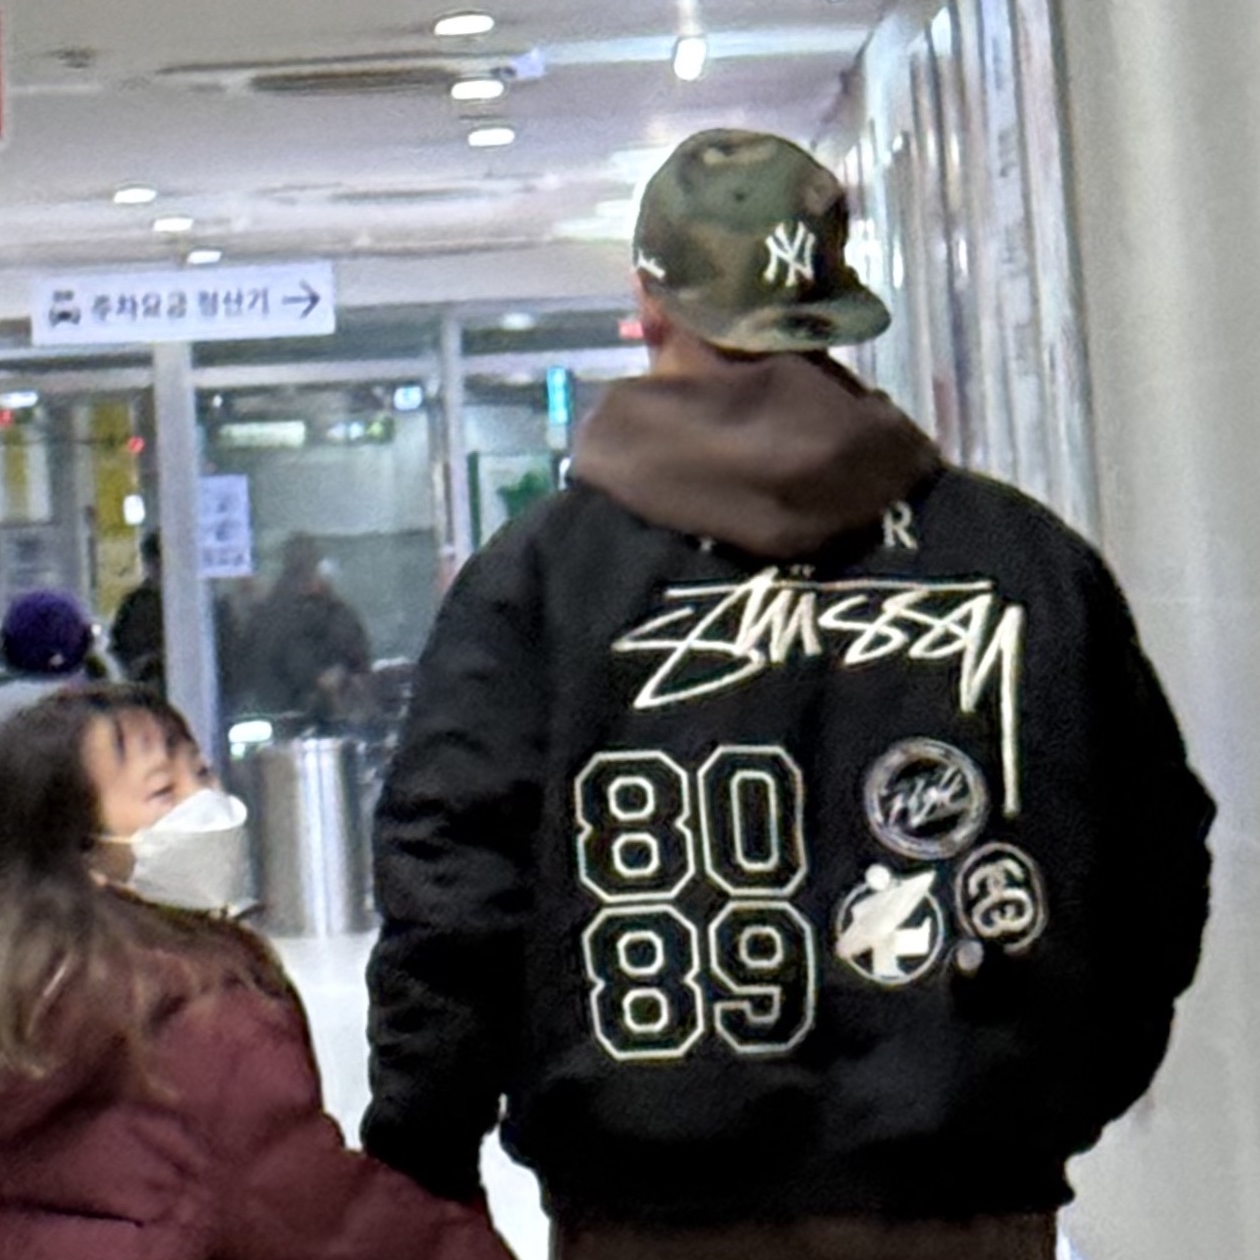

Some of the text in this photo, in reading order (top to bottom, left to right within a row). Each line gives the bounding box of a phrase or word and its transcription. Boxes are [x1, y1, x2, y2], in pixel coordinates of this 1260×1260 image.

[763, 221, 816, 288] NY
[574, 744, 809, 902] 80
[581, 899, 817, 1061] 89
